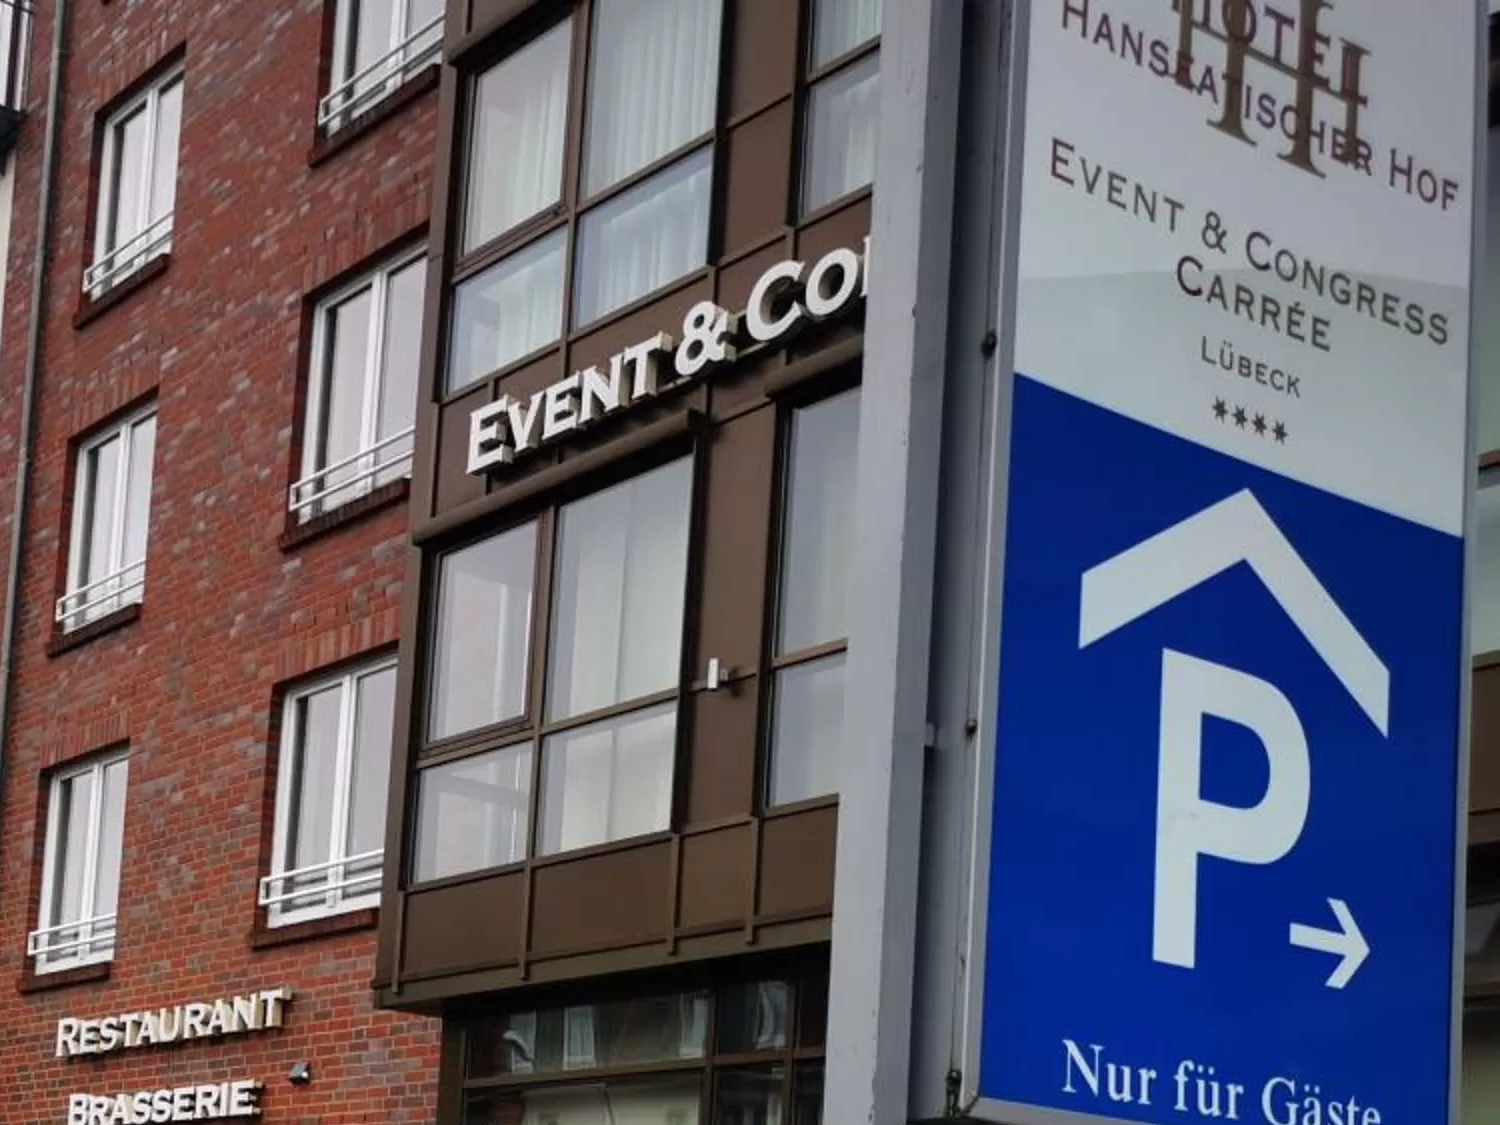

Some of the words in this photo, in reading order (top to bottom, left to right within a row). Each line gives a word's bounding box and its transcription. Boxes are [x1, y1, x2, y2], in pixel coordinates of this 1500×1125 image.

[1388, 148, 1460, 211] HOF
[1050, 137, 1185, 234] EVENT
[1201, 210, 1228, 254] &
[1245, 230, 1449, 346] CONGRESS
[1176, 255, 1332, 352] CARRÉE
[465, 330, 672, 476] EVENT
[675, 300, 737, 378] &
[746, 234, 872, 342] CO
[1201, 335, 1301, 398] LÜBECK
[1152, 646, 1312, 970] P
[55, 987, 295, 1058] RESTAURANT
[1061, 1038, 1157, 1106] Nur
[1173, 1059, 1245, 1122] für
